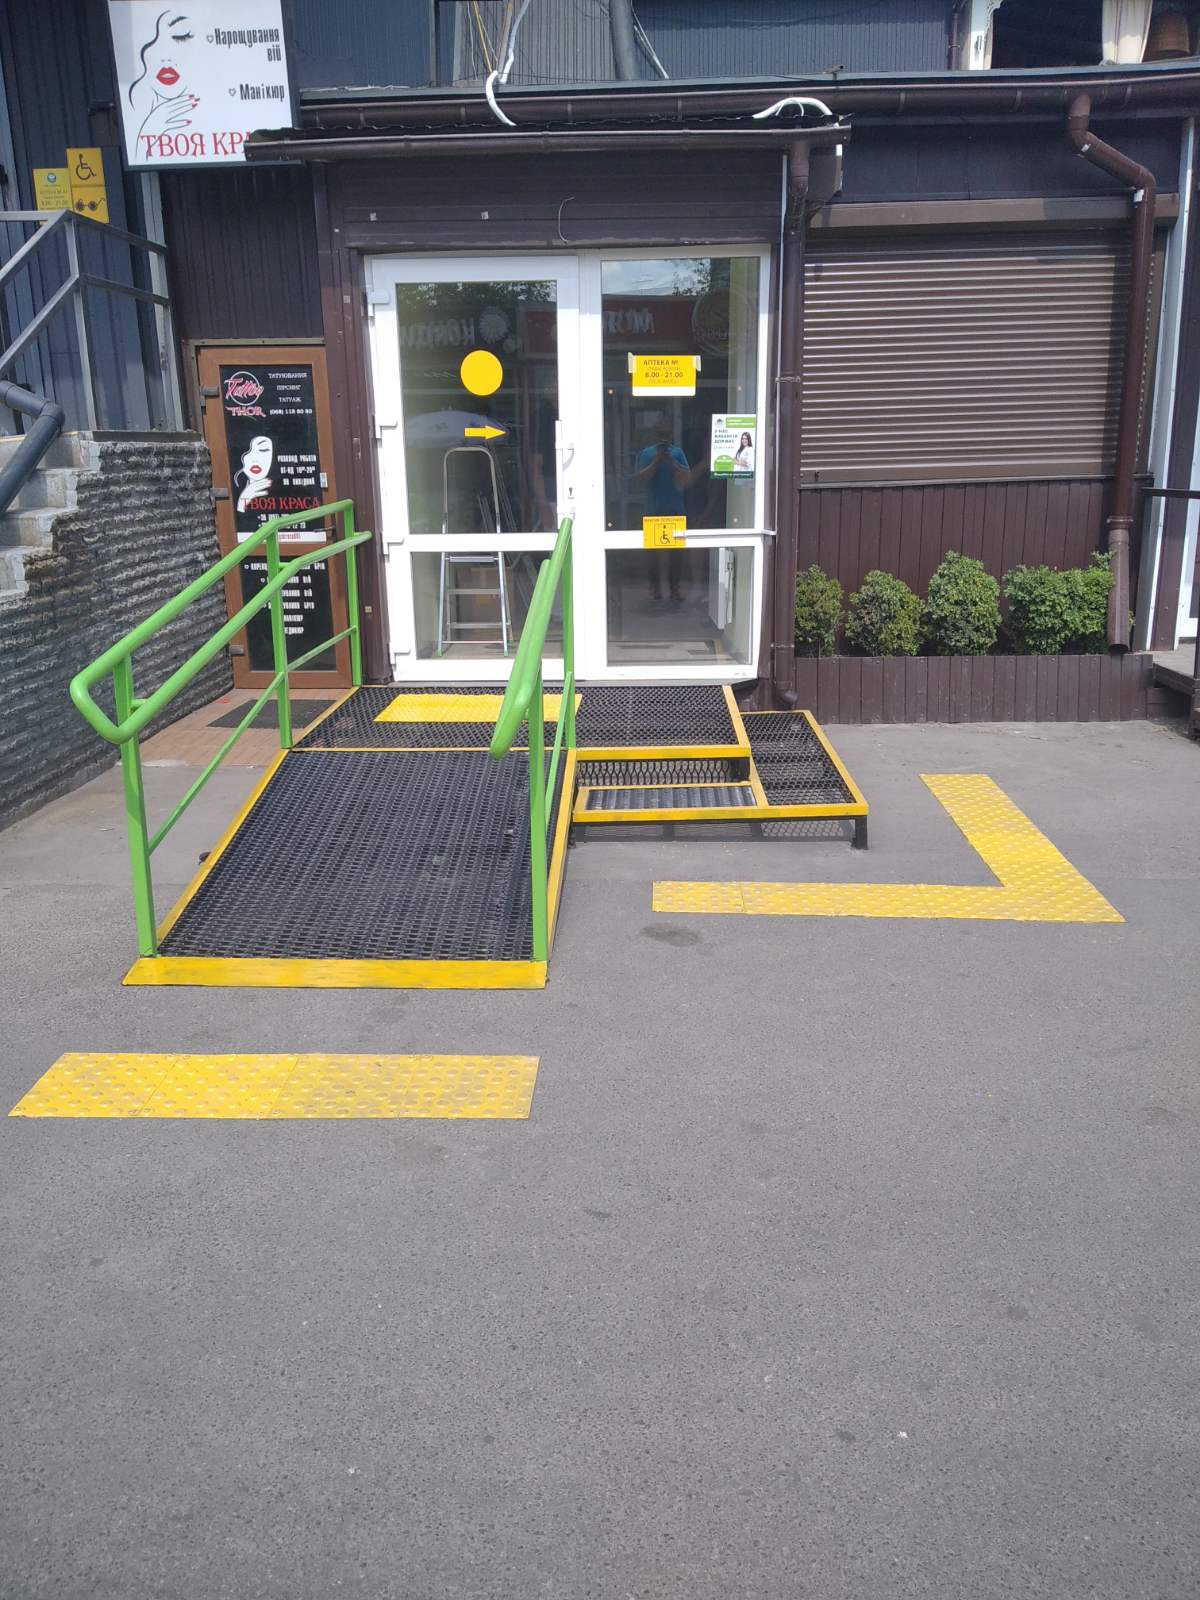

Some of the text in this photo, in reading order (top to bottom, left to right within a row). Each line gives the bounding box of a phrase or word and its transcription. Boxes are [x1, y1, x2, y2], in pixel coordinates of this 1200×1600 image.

[214, 28, 280, 49] Нарощування
[267, 45, 282, 62] вій
[240, 83, 285, 103] Манікюр
[141, 132, 206, 158] ТВОЯ
[279, 496, 320, 510] КРАСА
